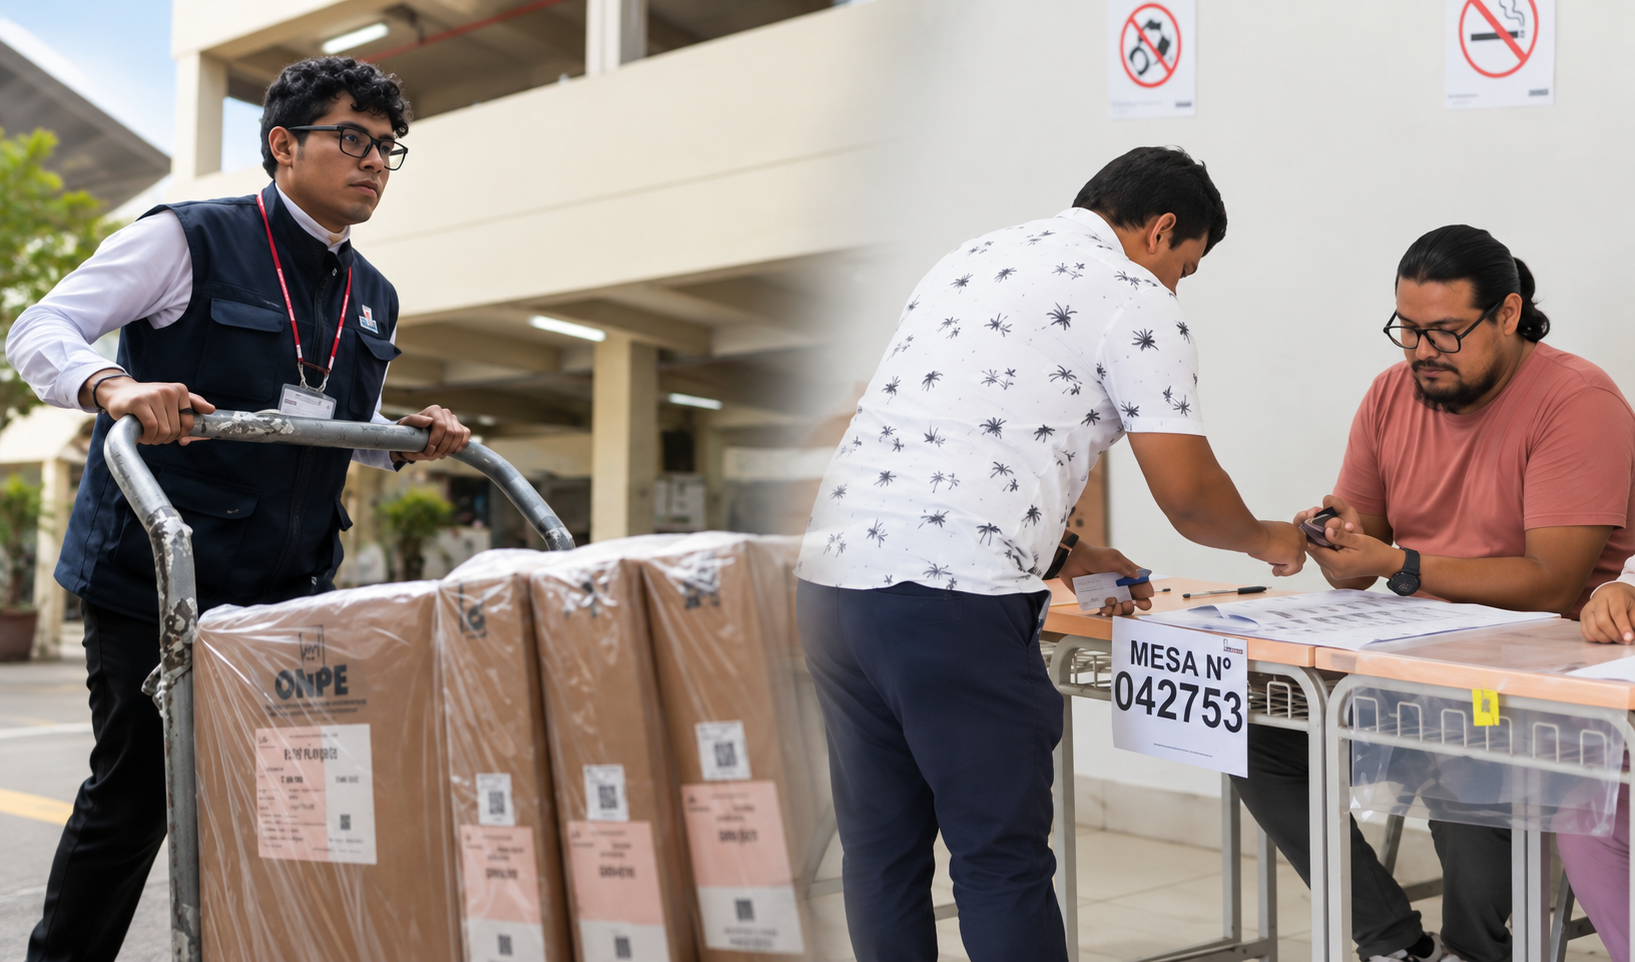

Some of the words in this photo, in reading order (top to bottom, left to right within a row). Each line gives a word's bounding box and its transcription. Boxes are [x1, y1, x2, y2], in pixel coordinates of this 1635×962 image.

[1130, 640, 1199, 677] MESA
[275, 664, 349, 700] ONPE
[1114, 670, 1243, 733] 042753
